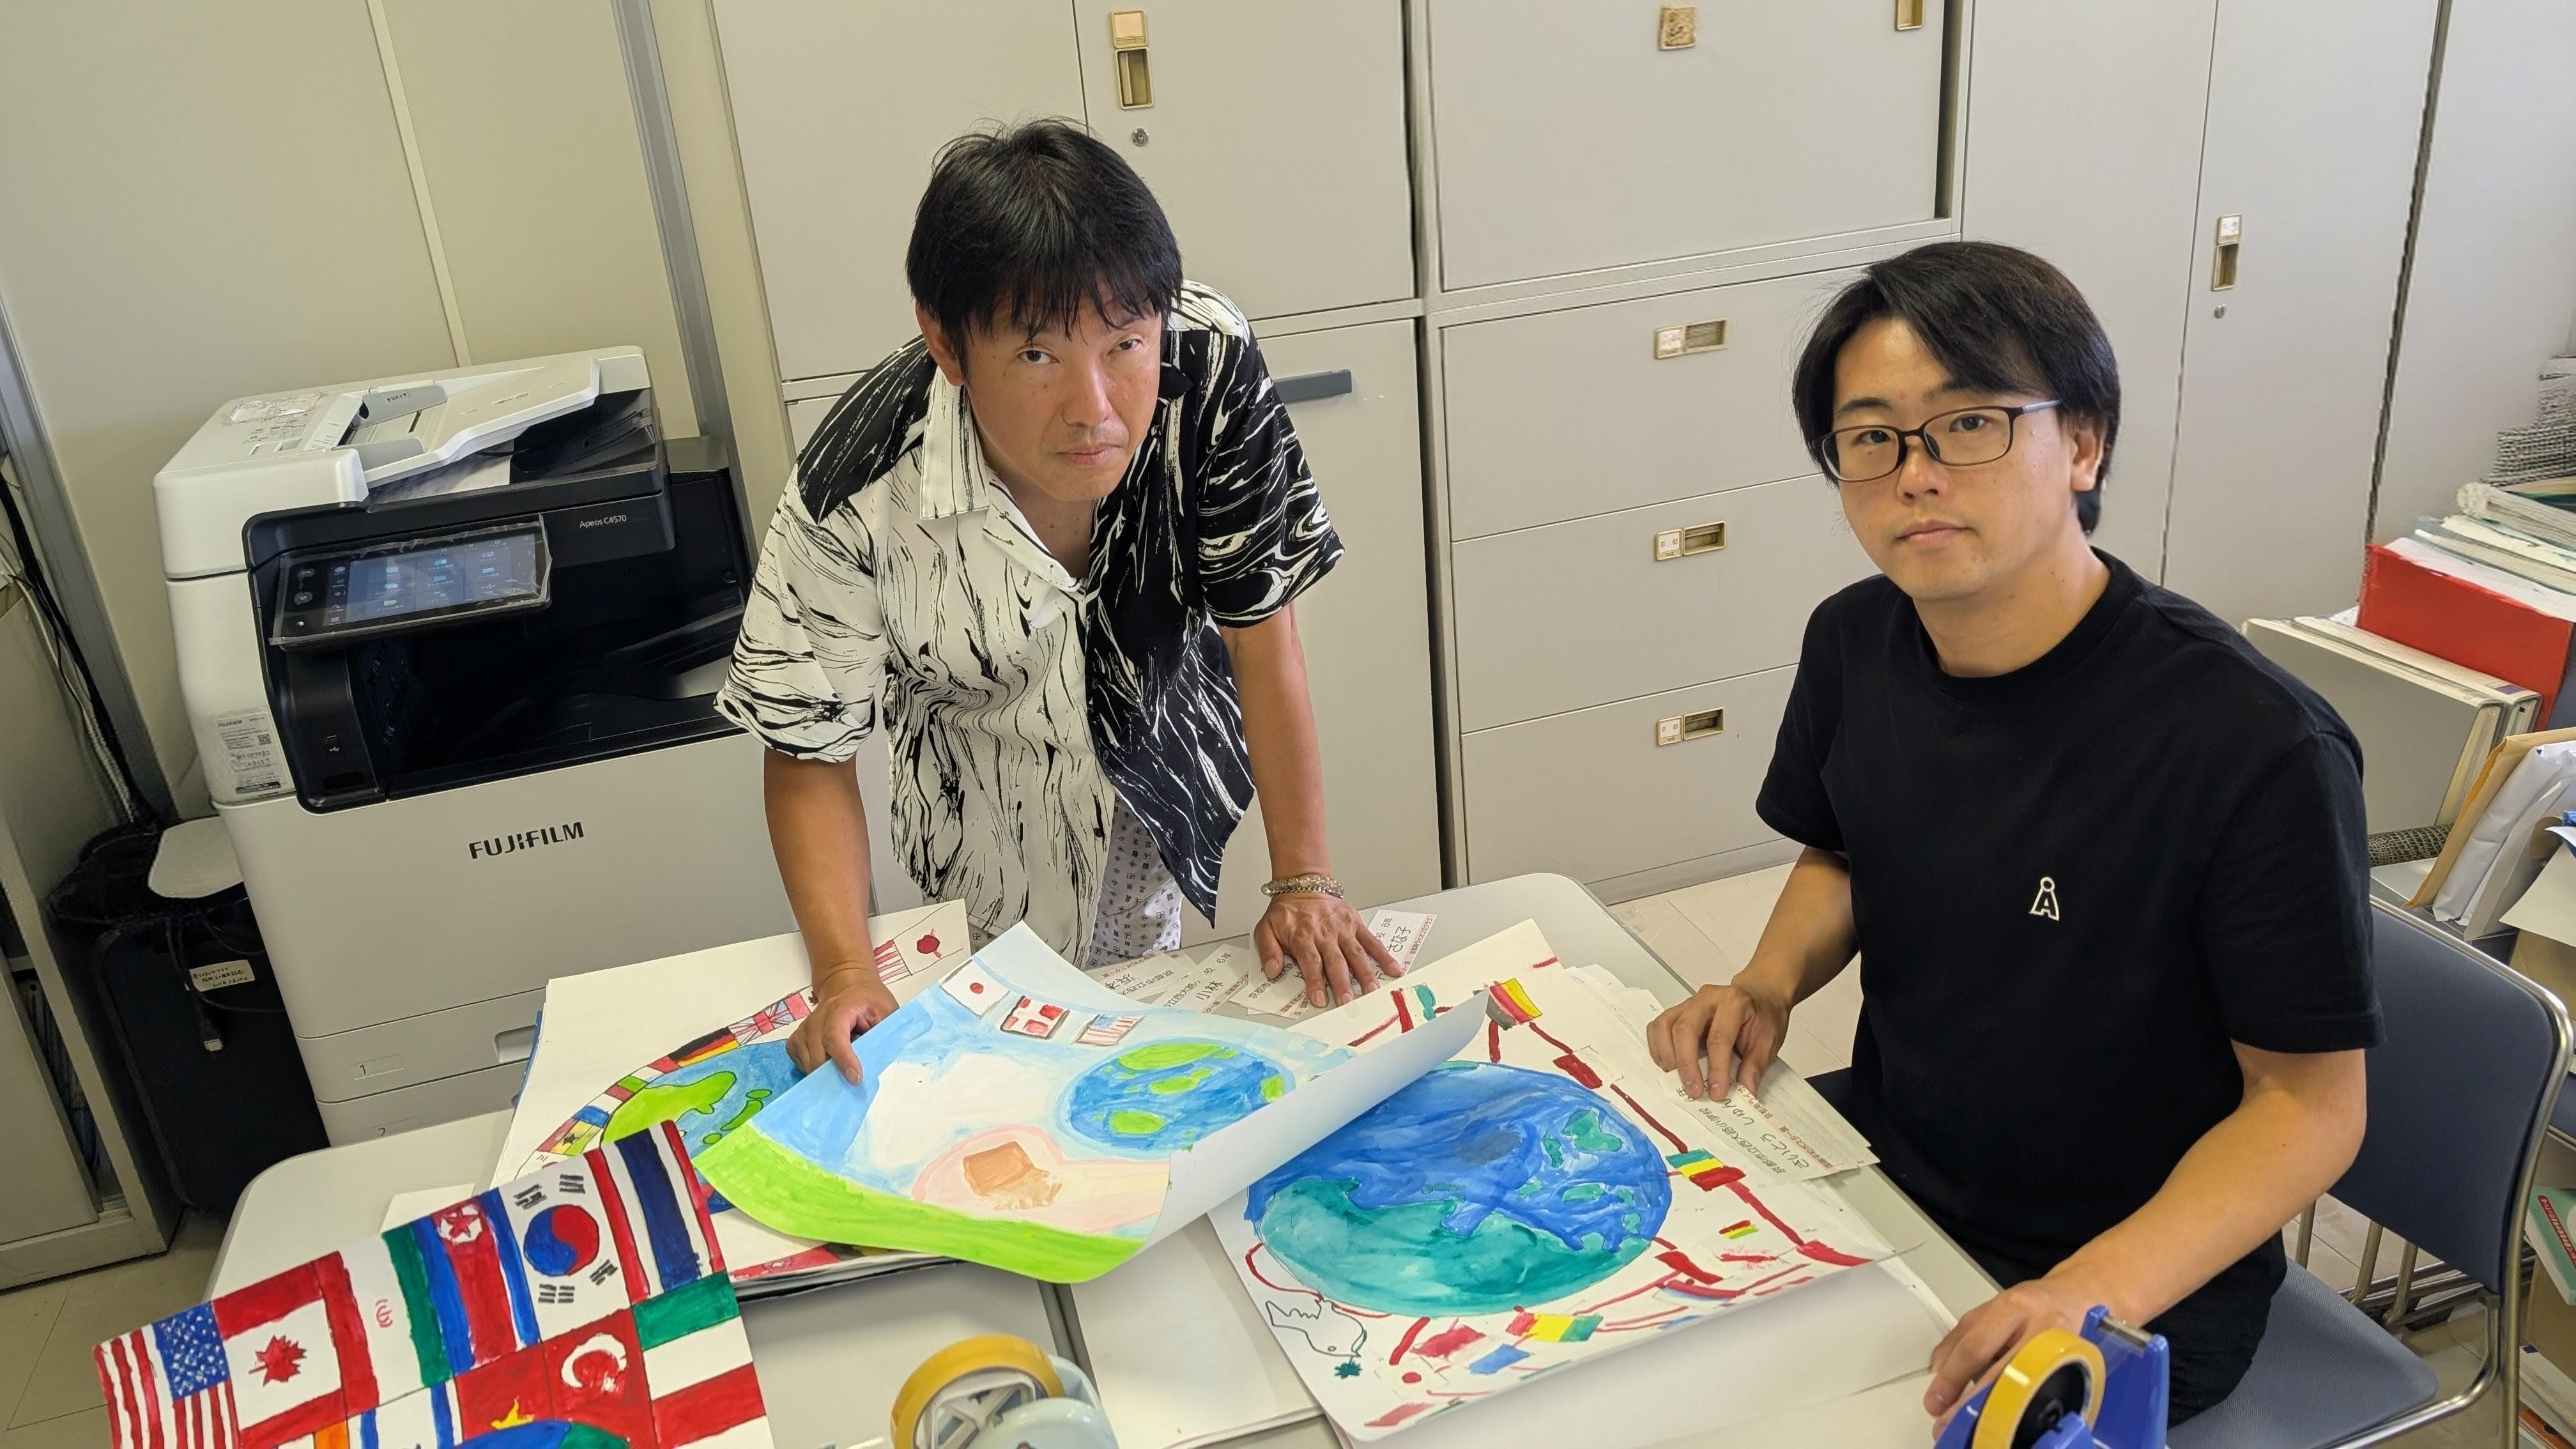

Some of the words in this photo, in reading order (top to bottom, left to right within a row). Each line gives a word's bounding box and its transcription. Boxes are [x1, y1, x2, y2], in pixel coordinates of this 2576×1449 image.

[579, 519, 602, 529] Apeos
[603, 515, 627, 525] C4570
[468, 822, 585, 859] FUJIFILM
[1386, 925, 1411, 953] さな子
[1195, 980, 1223, 1000] 小林
[359, 1064, 367, 1075] 1
[1759, 1133, 1810, 1170] さいとう
